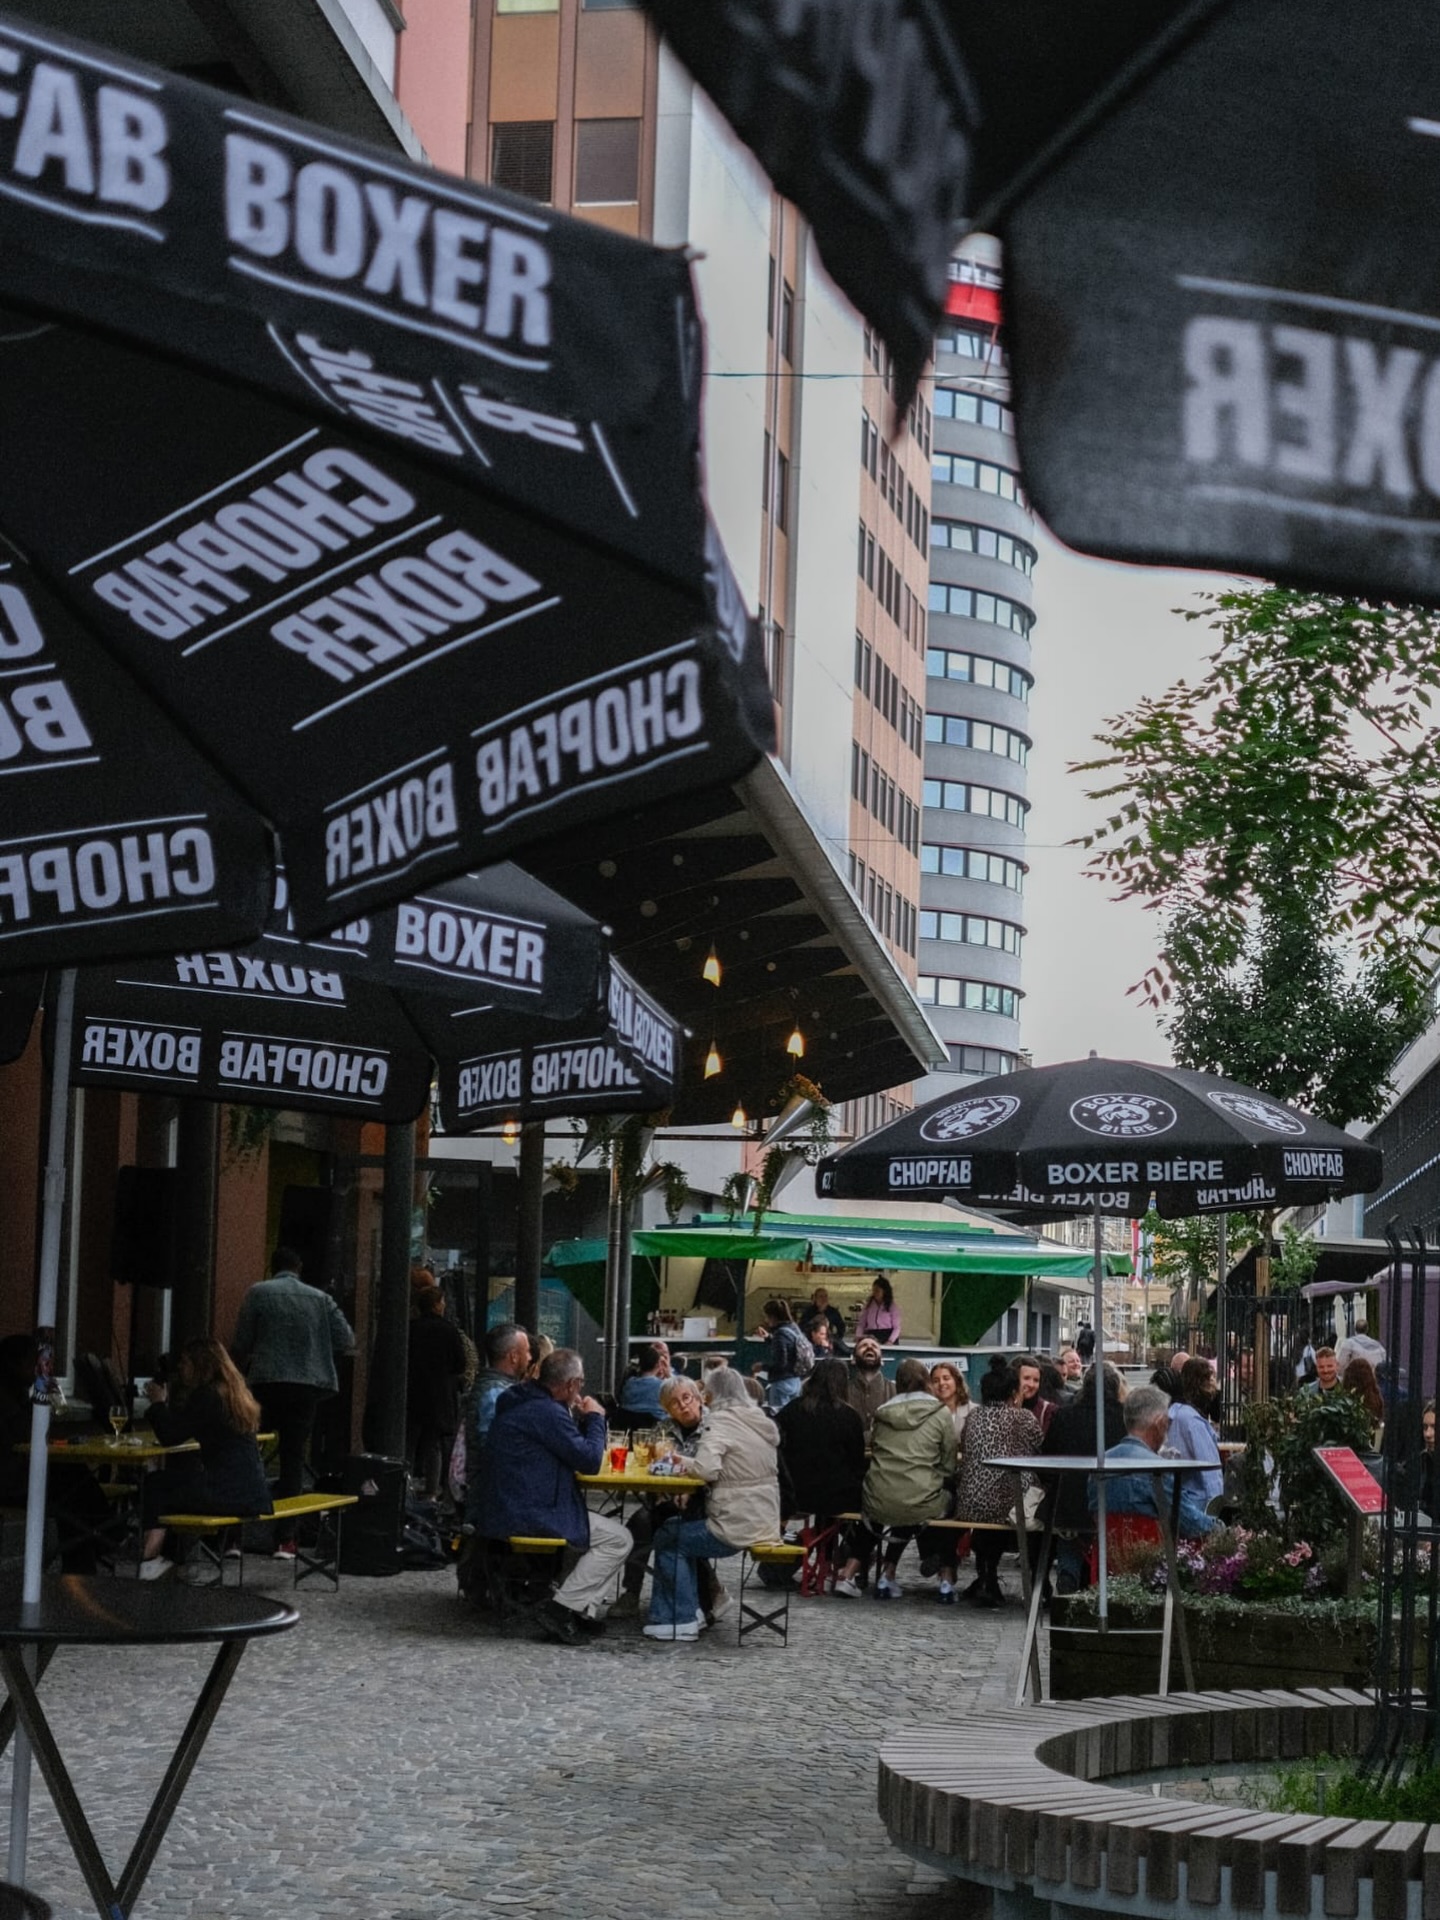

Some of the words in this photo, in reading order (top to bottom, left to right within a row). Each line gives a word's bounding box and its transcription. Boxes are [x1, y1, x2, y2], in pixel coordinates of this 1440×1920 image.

[225, 133, 551, 347] BOXER
[394, 903, 546, 984] BOXER
[1080, 1095, 1158, 1110] BOXER
[888, 1159, 973, 1187] CHOPFAB
[1047, 1160, 1139, 1185] BOXER
[1145, 1156, 1225, 1183] BIÈRE
[1283, 1151, 1345, 1178] CHOPFAB
